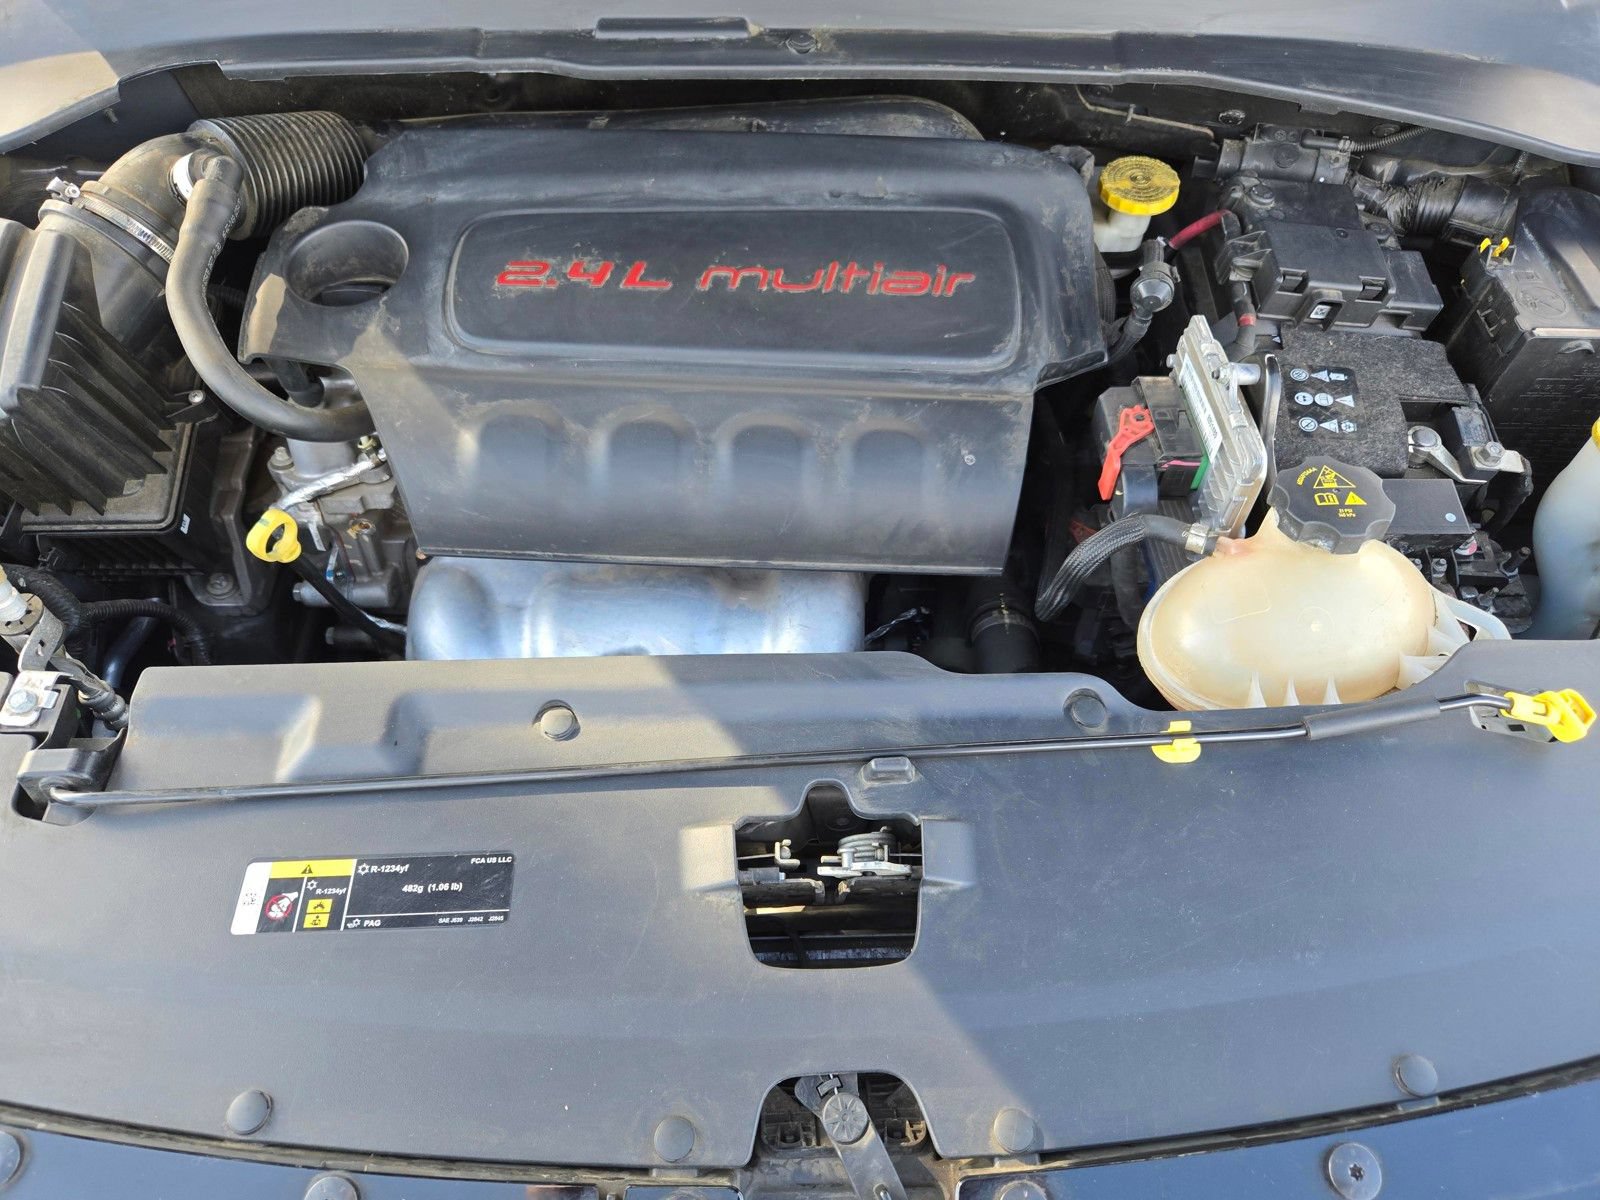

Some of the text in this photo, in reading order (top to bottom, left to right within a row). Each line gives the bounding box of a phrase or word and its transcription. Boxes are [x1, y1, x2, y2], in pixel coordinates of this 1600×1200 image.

[497, 260, 976, 297] 2.4L multiair
[471, 857, 485, 865] FCA
[498, 856, 513, 864] LLC
[370, 864, 409, 875] R-1234yf
[316, 887, 347, 897] R-1234yf
[402, 882, 463, 894] 482g (1.06 lb)
[363, 919, 381, 928] PAG
